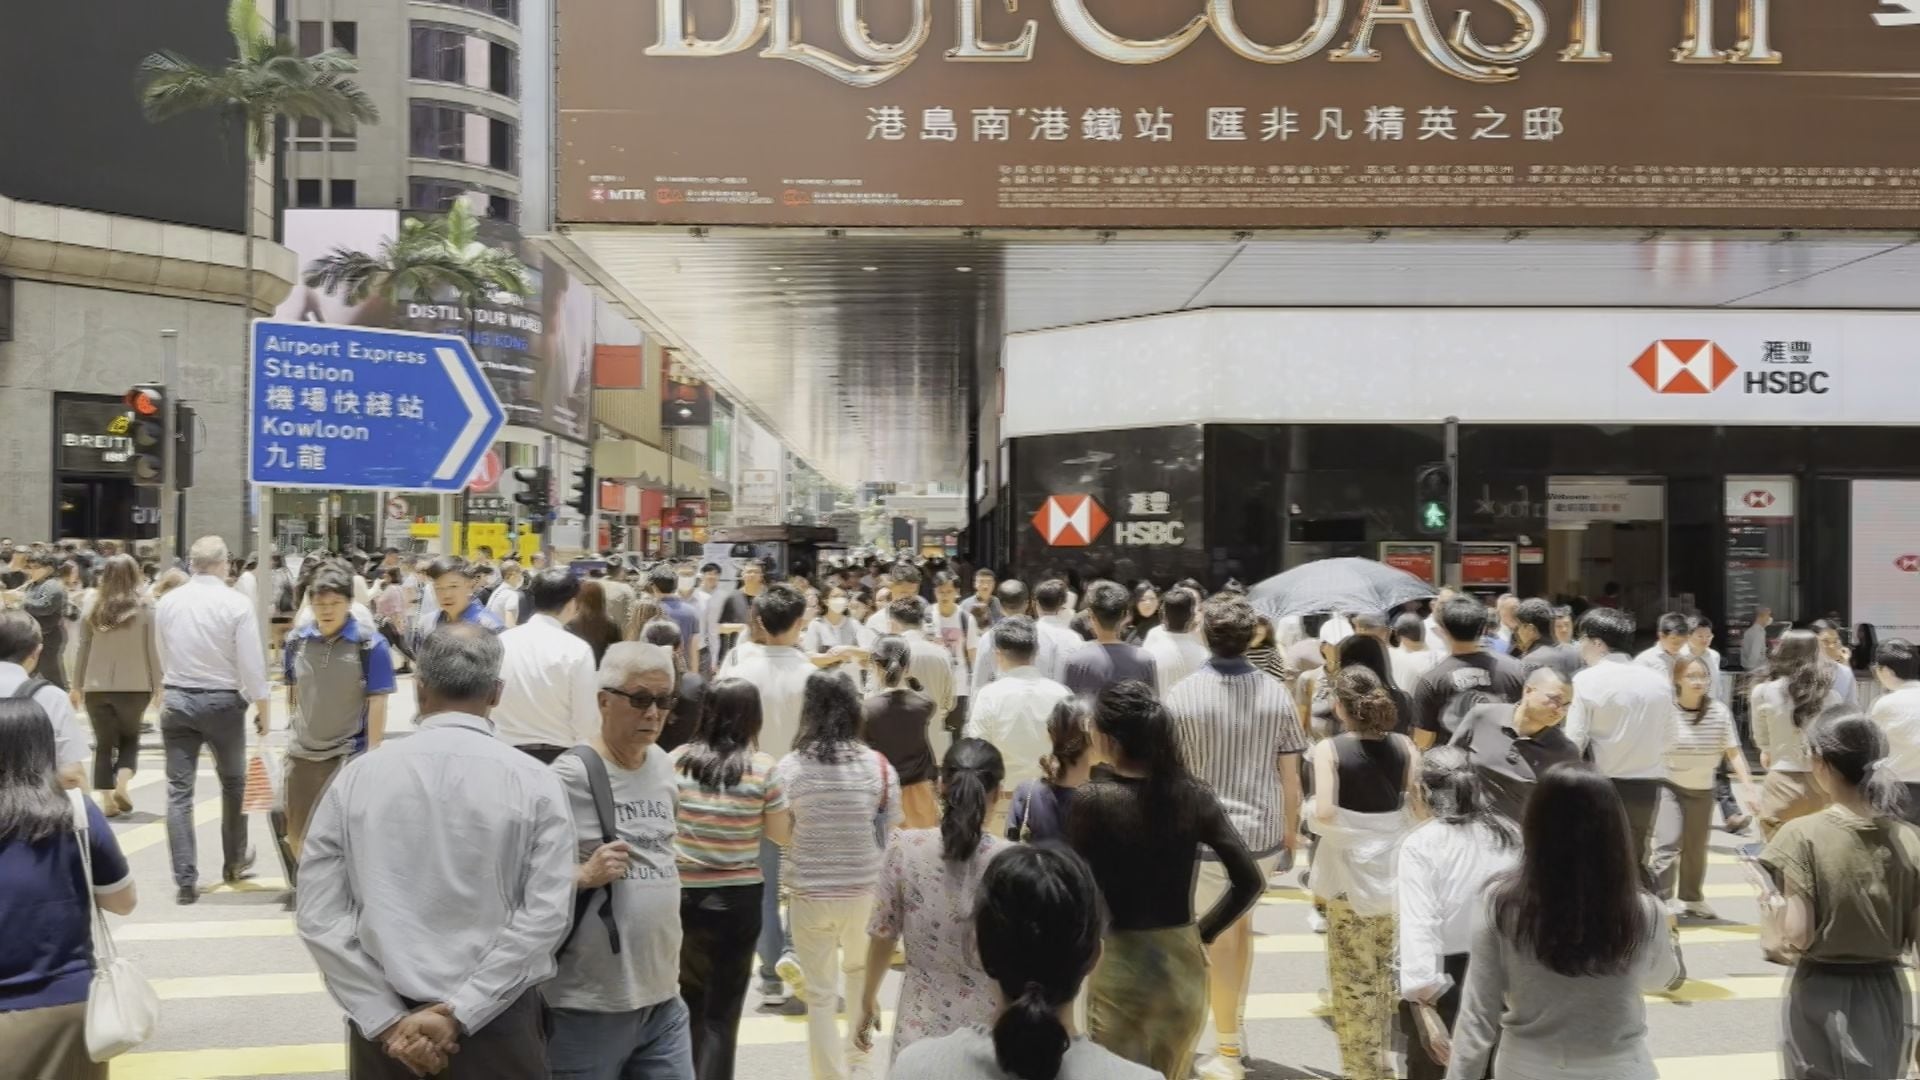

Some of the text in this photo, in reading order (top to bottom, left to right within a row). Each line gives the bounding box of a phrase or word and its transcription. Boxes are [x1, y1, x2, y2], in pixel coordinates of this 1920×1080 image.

[608, 188, 646, 200] MTR
[264, 335, 427, 365] Airport Express
[264, 358, 354, 382] Station
[1744, 371, 1830, 394] HSBC
[261, 416, 370, 441] Kowloon
[263, 442, 327, 470] 九龍
[1115, 521, 1185, 545] HSBC
